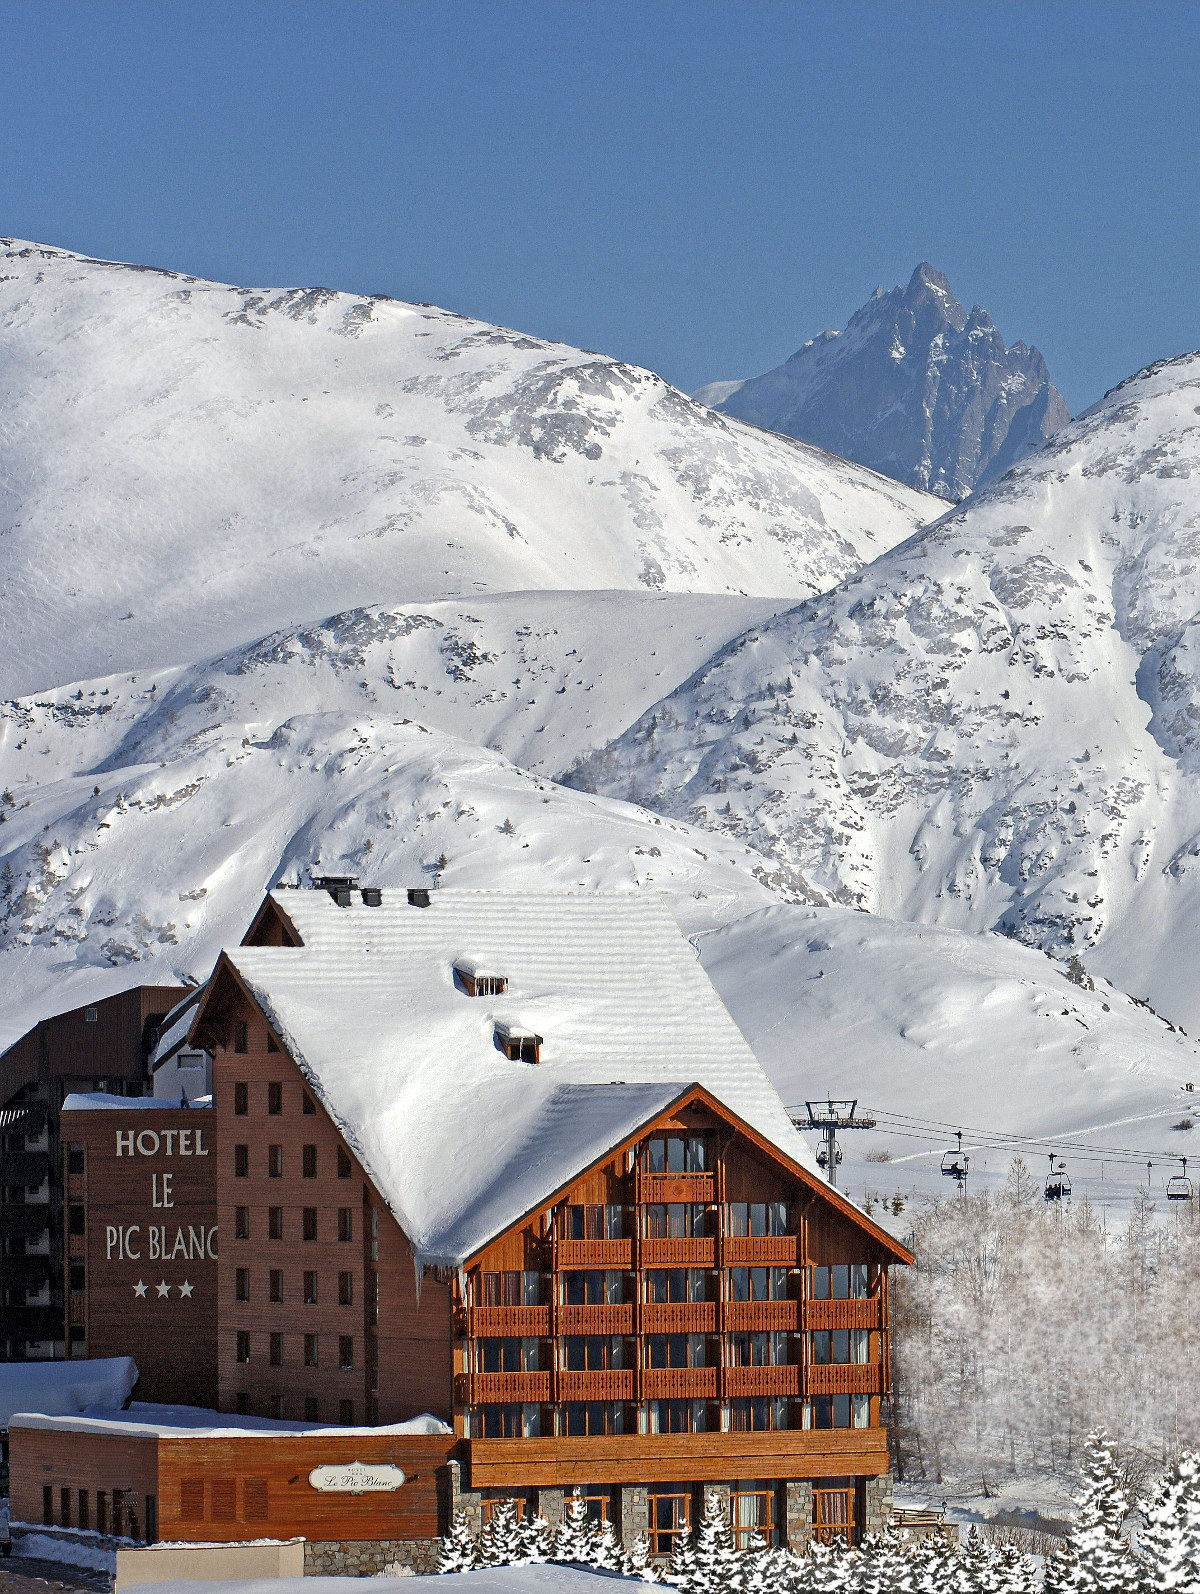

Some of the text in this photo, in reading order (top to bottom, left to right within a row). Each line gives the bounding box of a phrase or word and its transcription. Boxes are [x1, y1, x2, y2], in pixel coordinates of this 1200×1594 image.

[116, 1129, 209, 1156] HOTEL
[152, 1173, 174, 1208] LE
[106, 1225, 219, 1260] PIC BLANC
[324, 1474, 393, 1487] Le Pic Blanc
